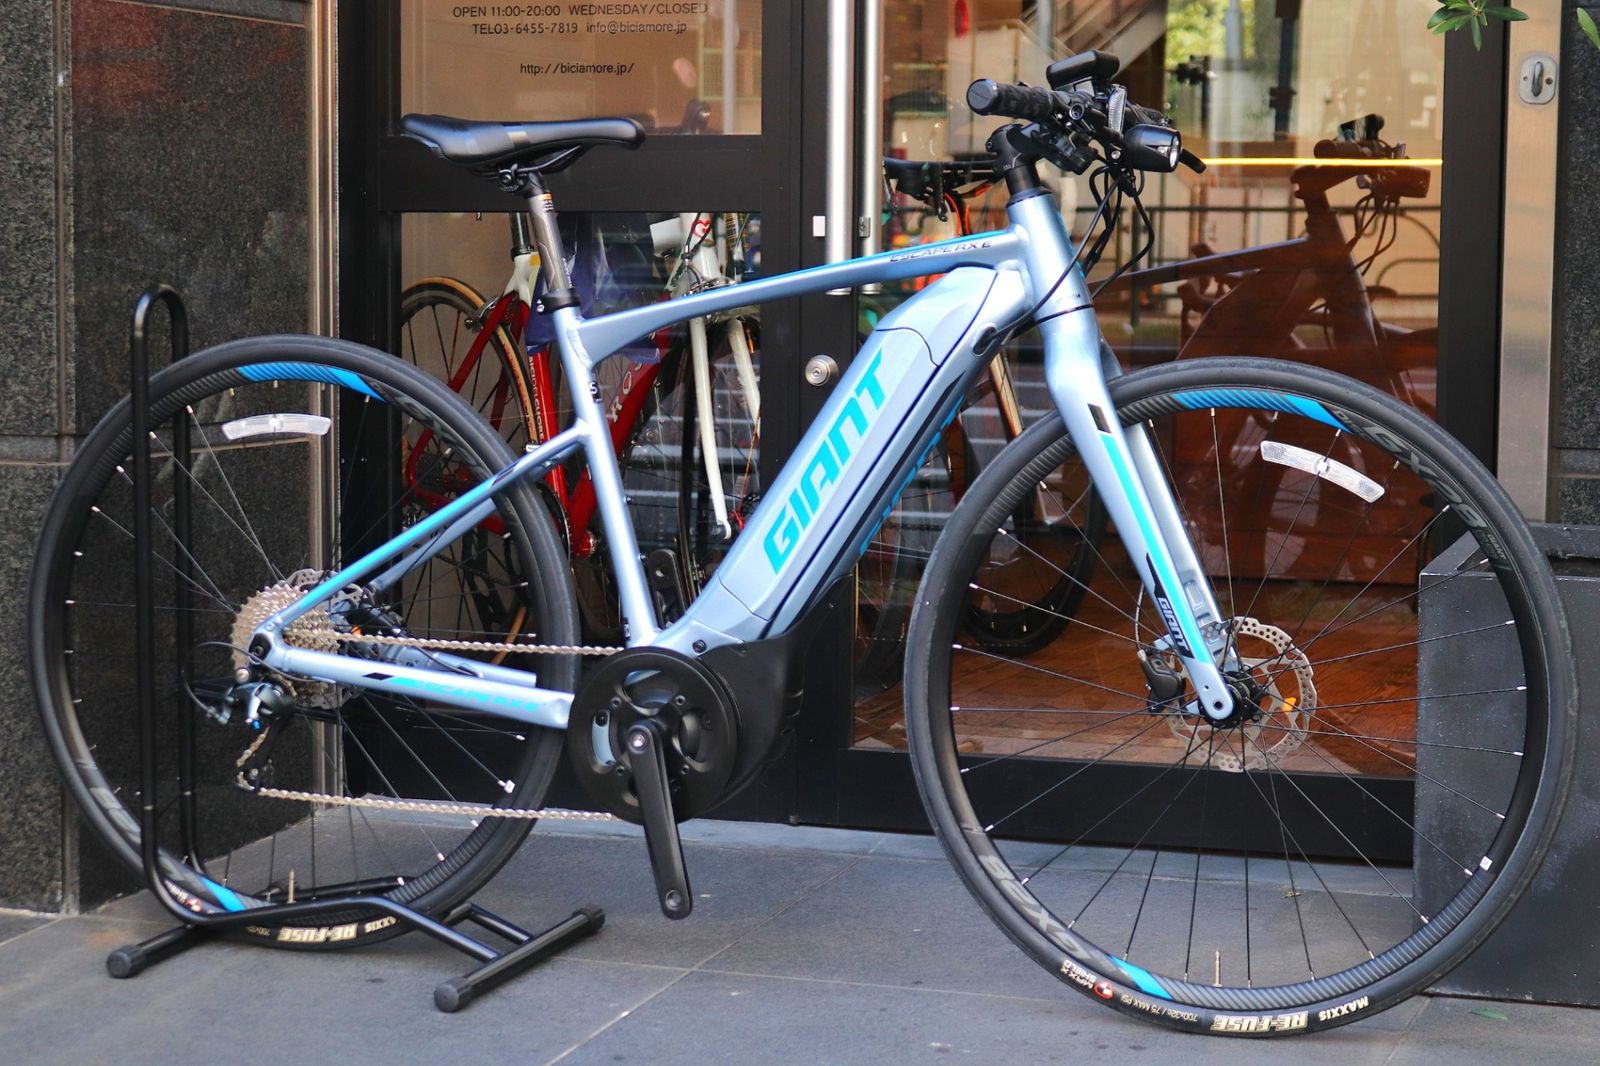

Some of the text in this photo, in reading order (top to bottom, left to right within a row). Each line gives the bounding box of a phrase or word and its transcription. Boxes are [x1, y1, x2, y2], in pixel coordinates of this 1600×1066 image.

[452, 6, 487, 18] OPEN
[491, 5, 561, 17] 11:00-20:00
[472, 22, 687, 35] TEL03-6455-7819 info@biciamore.jp
[520, 62, 635, 76] http://biciamore.jp/
[763, 347, 886, 576] GIANT
[1157, 596, 1190, 650] GIANT
[276, 922, 359, 943] RE-FUSE
[1063, 959, 1097, 983] SHIELD
[1318, 995, 1369, 1022] MAXXIS
[1210, 1010, 1309, 1033] RE-FUSE
